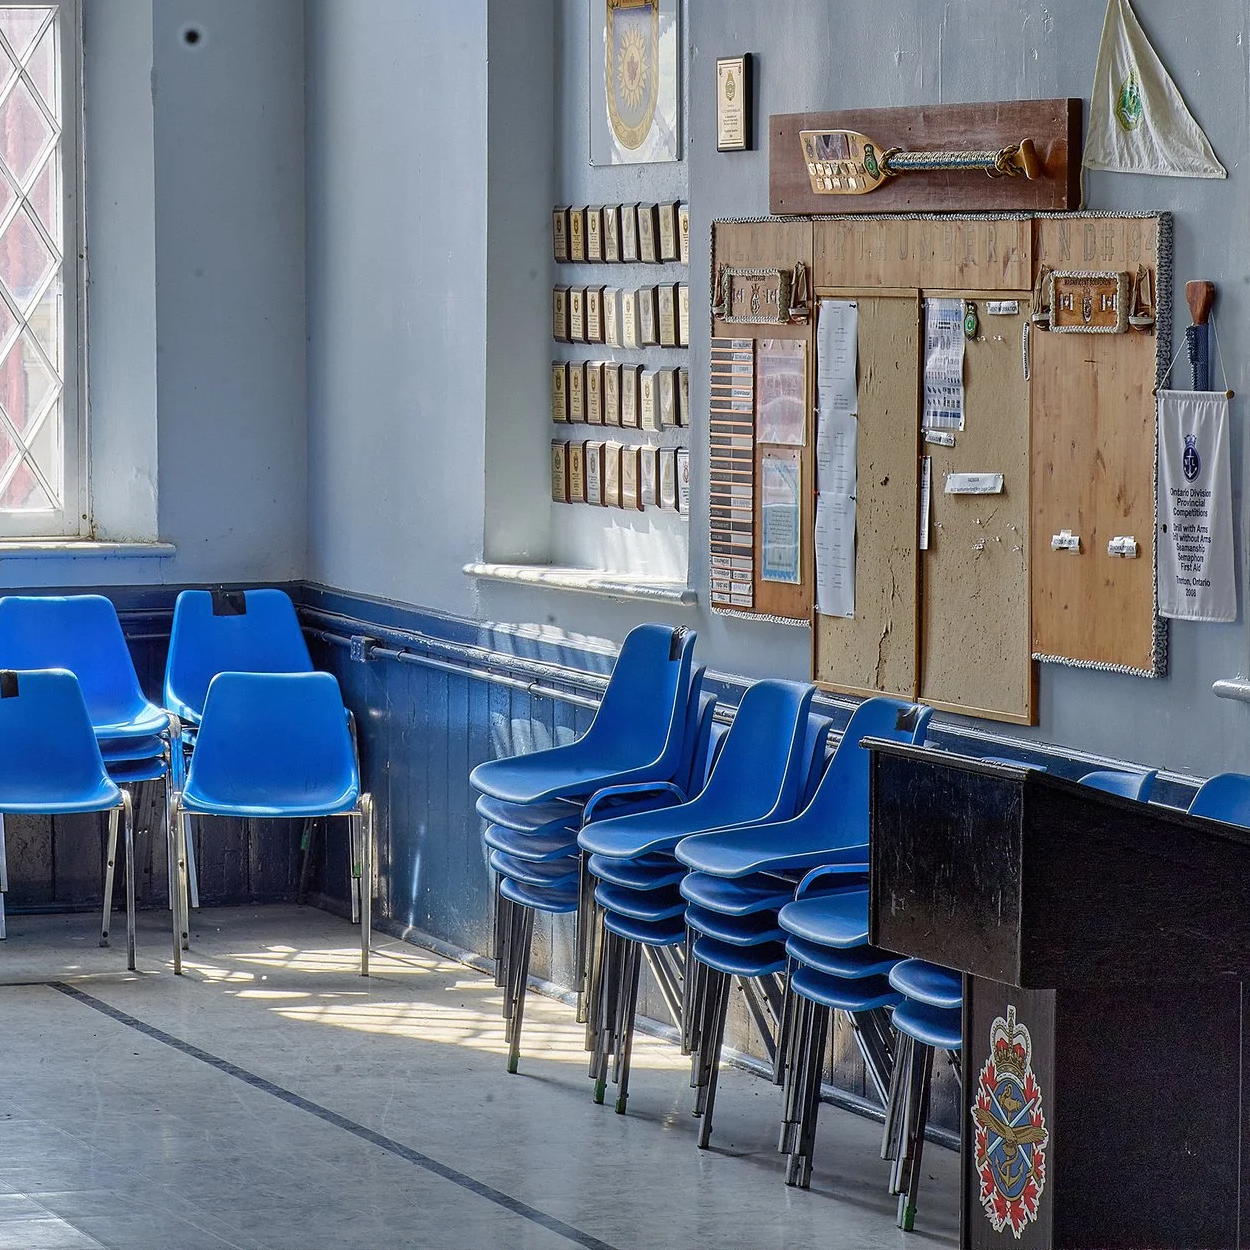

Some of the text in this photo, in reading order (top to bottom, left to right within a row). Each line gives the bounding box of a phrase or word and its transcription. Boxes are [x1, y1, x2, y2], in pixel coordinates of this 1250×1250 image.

[1170, 488, 1211, 498] Ontario Division
[1177, 498, 1205, 507] Provincial
[1173, 508, 1208, 518] Competitions
[1183, 524, 1196, 533] with
[1180, 534, 1199, 543] without
[1200, 535, 1211, 544] Arms
[1177, 543, 1205, 554] Seamanship
[1178, 553, 1204, 563] Semaphore
[1181, 563, 1201, 572] First Aid
[1193, 577, 1211, 587] Ontario
